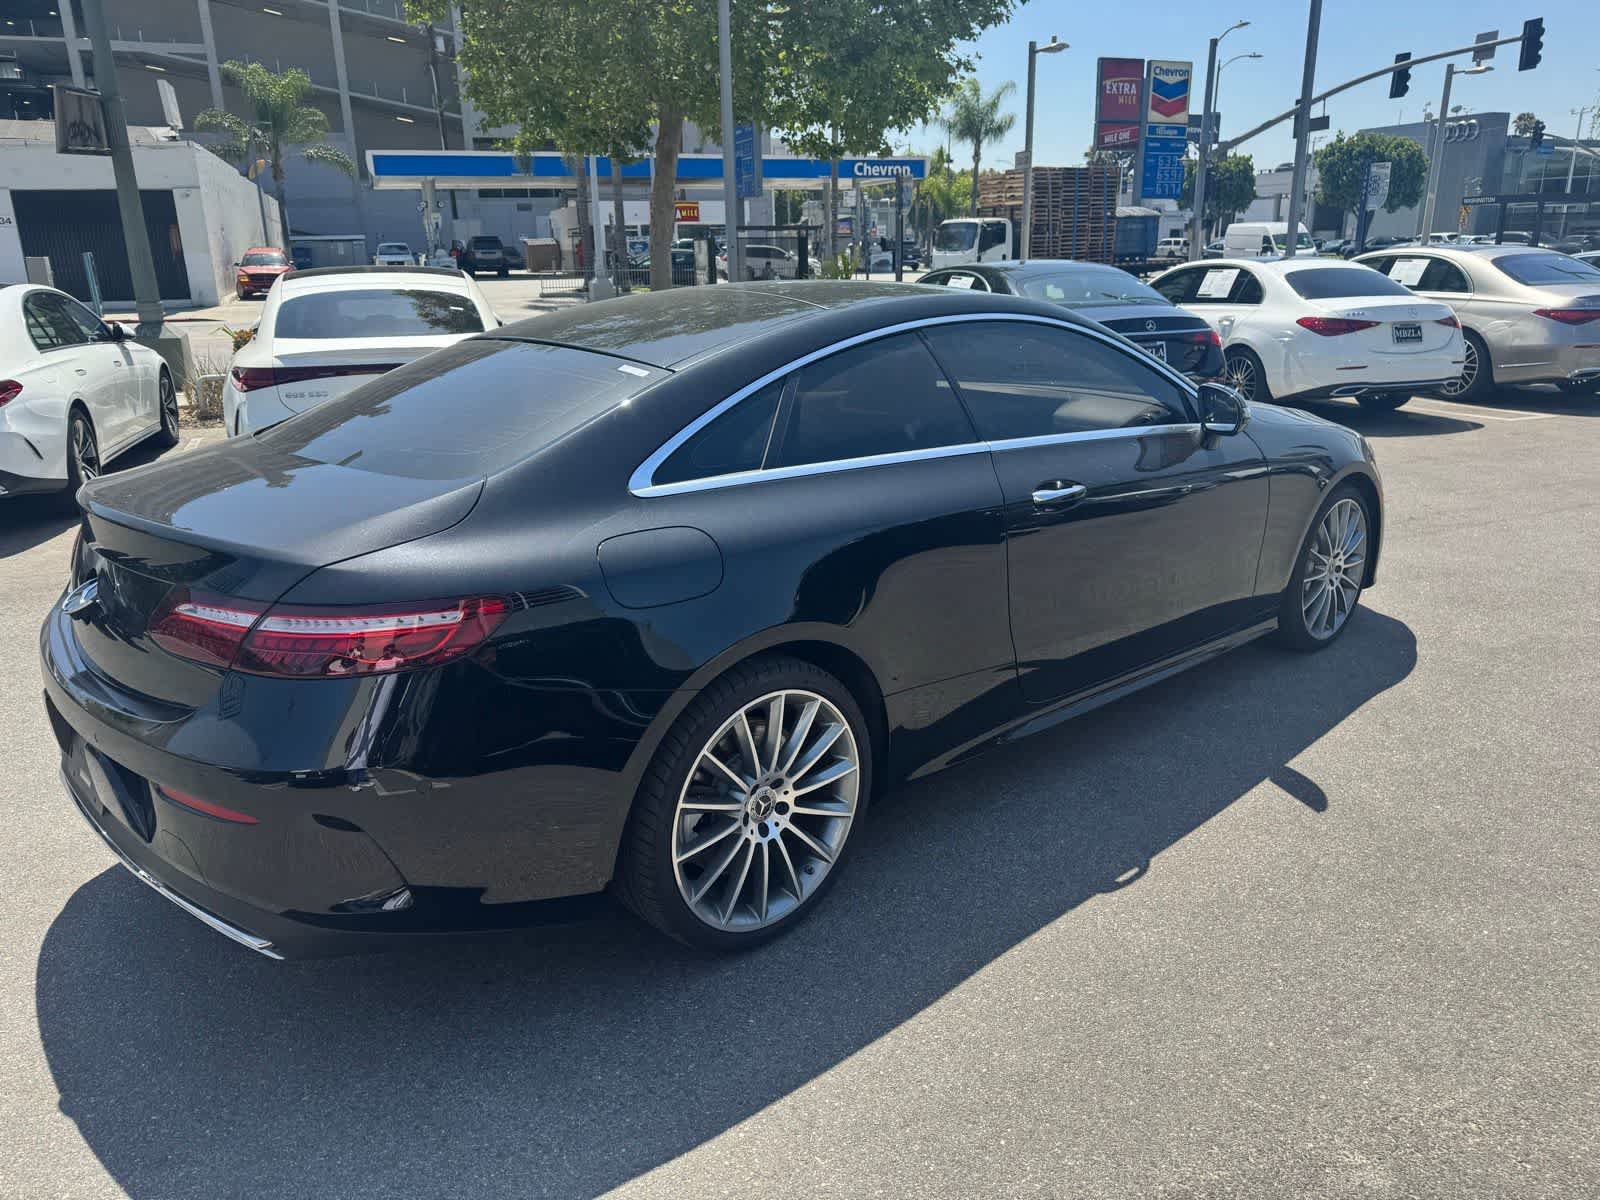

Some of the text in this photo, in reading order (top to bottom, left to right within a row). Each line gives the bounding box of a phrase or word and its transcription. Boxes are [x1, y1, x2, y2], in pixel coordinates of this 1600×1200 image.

[1153, 66, 1189, 77] Chevron
[1105, 82, 1137, 94] EXTRA
[1118, 95, 1136, 105] MILE
[853, 162, 911, 177] Chevron
